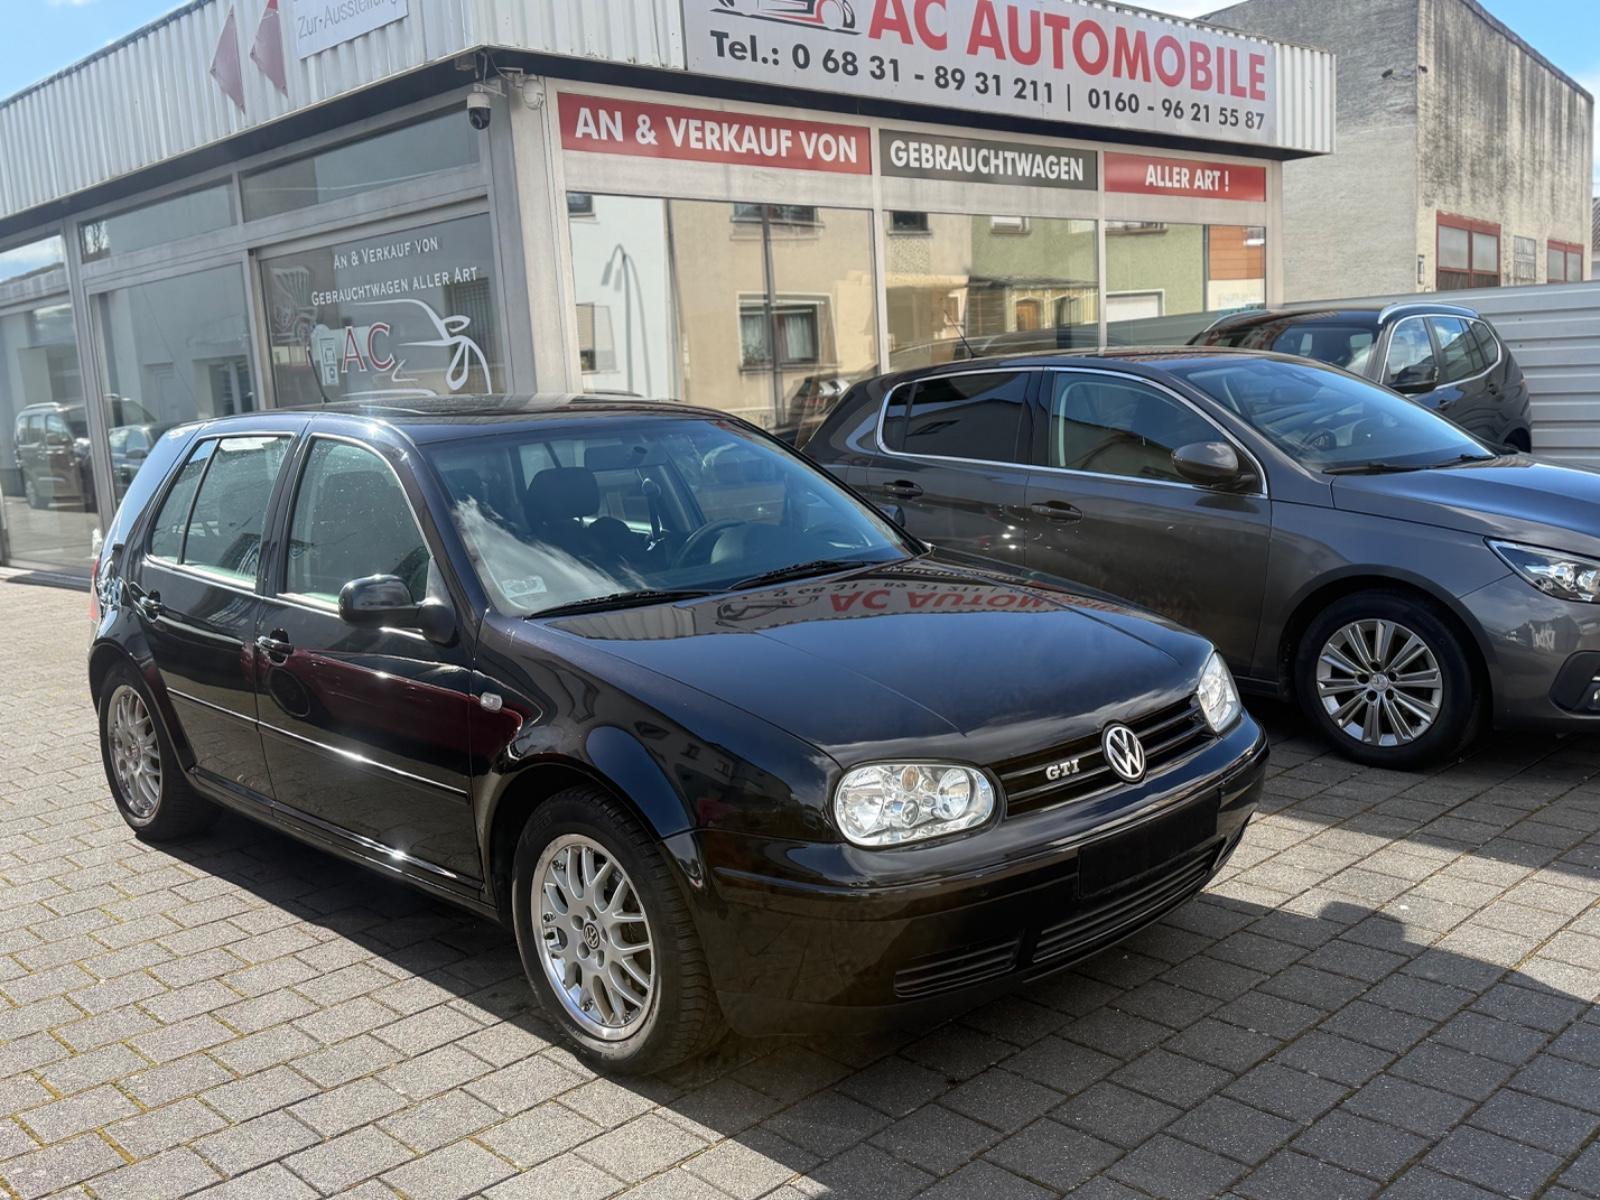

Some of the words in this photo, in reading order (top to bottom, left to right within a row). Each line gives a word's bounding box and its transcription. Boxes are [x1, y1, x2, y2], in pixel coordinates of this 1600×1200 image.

[324, 0, 398, 29] Ausste
[868, 0, 948, 51] AC
[966, 0, 1266, 101] AUTOMOBILE
[709, 29, 780, 66] Tel.:
[791, 43, 811, 70] 0
[822, 48, 859, 76] 68
[869, 55, 900, 82] 31
[934, 65, 966, 91] 89
[975, 72, 1001, 97] 31
[1013, 77, 1053, 104] 211
[1087, 88, 1140, 114] 0160
[1161, 98, 1185, 120] 96
[1190, 102, 1210, 123] 21
[1218, 107, 1239, 128] 55
[1245, 110, 1265, 131] 87
[574, 106, 624, 143] AN
[635, 113, 658, 145] &
[665, 116, 792, 157] VERKAUF
[799, 130, 857, 164] VON
[889, 139, 1084, 182] GEBRAUCHTWAGEN
[1144, 163, 1191, 190] ALLER
[1193, 170, 1221, 192] ART
[351, 250, 360, 267] &
[361, 241, 412, 264] VERKAUF
[415, 236, 439, 254] VON
[311, 278, 409, 307] GEBRAUCHTWAGEN
[412, 271, 450, 290] ALLER
[454, 265, 478, 284] ART
[340, 321, 396, 374] AC
[1045, 758, 1081, 781] GTI
[1104, 725, 1146, 779] VW
